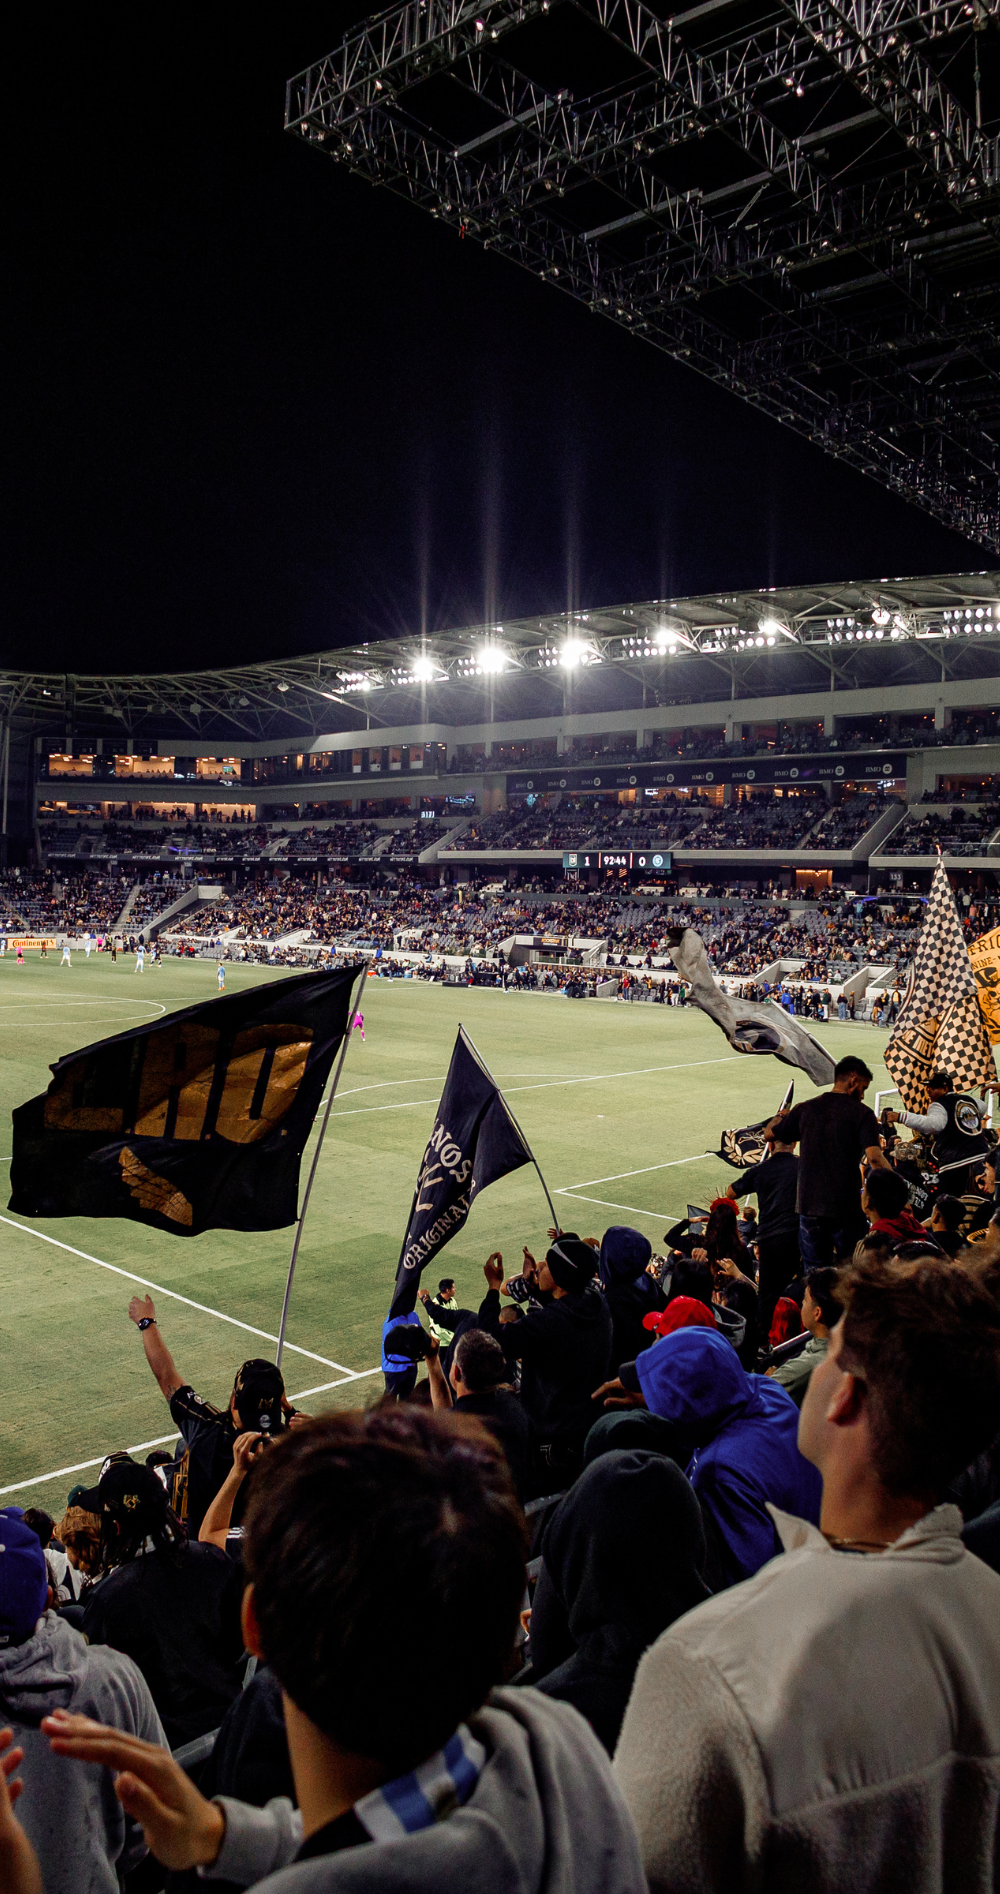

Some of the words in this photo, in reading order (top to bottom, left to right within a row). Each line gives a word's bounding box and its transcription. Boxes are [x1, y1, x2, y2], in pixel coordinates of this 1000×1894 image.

[584, 856, 590, 866] 1
[639, 857, 646, 867] 0
[12, 940, 50, 948] Continenl
